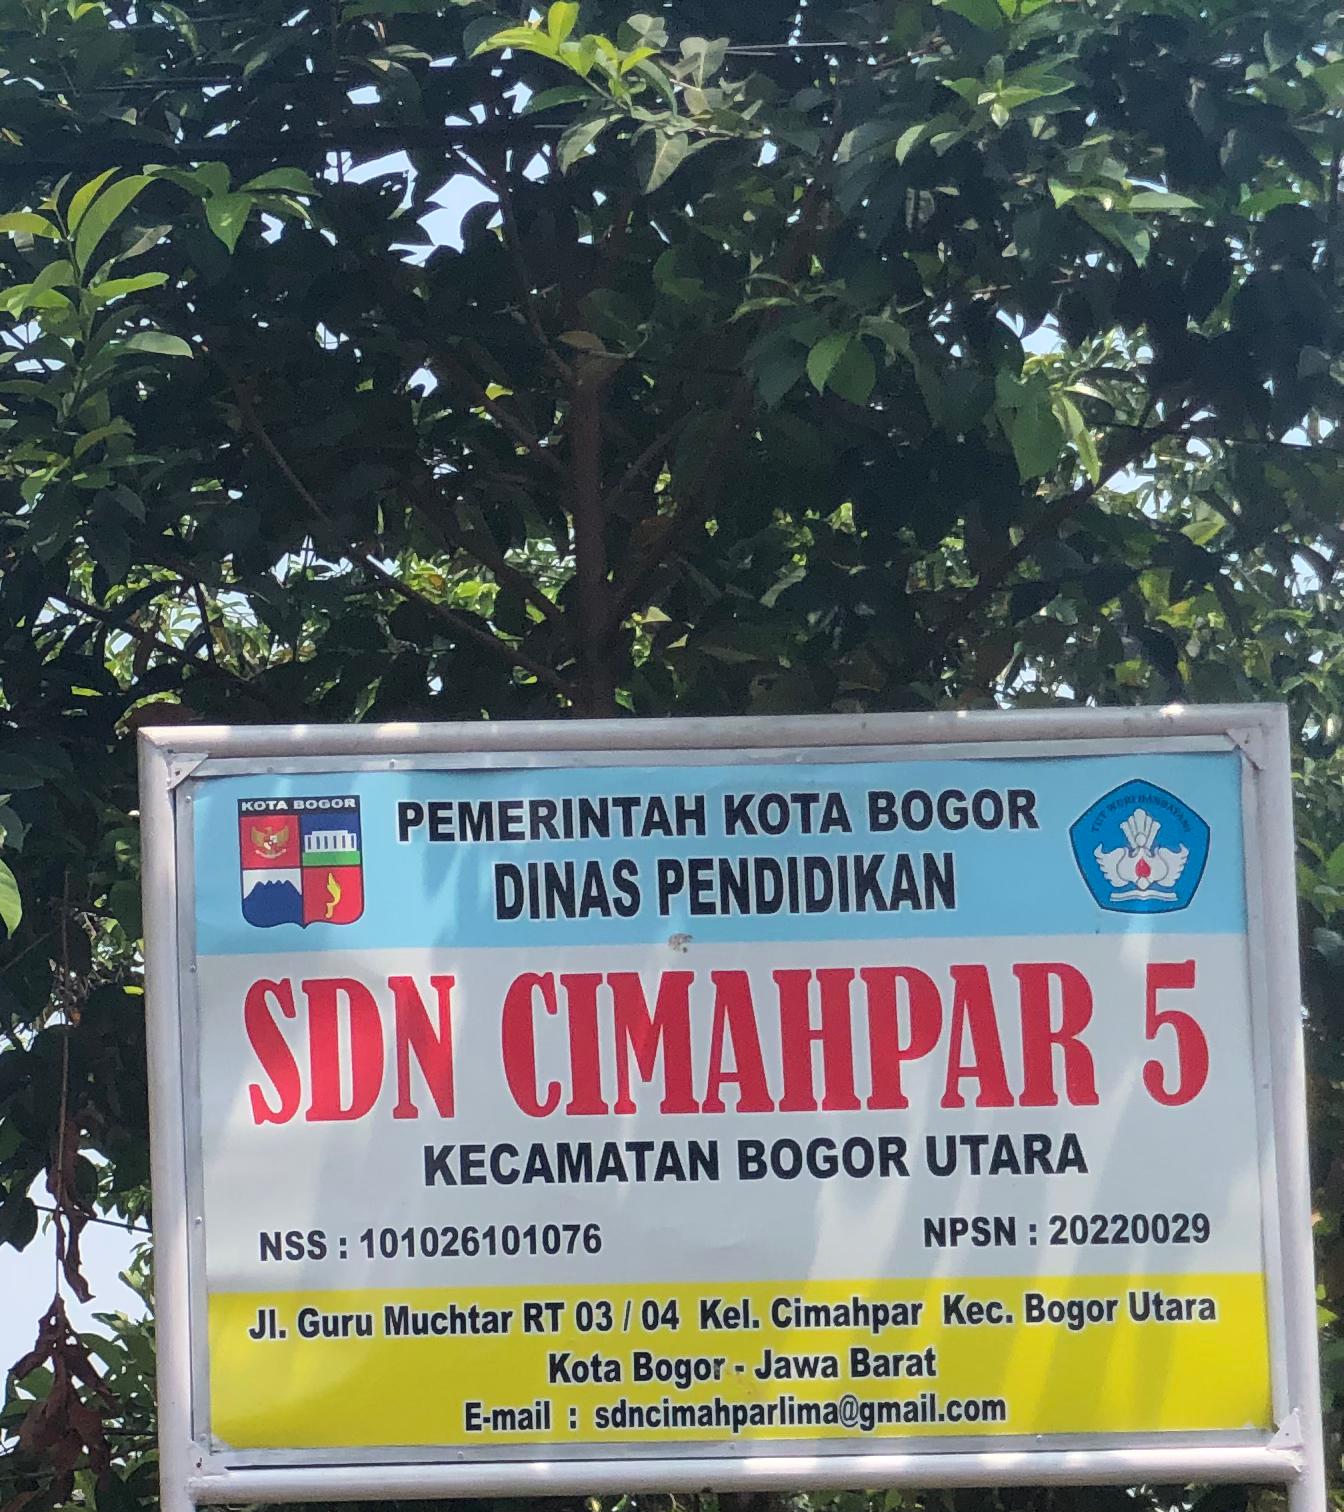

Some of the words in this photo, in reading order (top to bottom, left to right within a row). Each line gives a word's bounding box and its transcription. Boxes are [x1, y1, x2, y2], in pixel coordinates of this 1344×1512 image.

[242, 801, 288, 810] KOTA
[294, 799, 355, 809] BOGOR
[399, 796, 705, 841] PEMERINTAH
[725, 793, 852, 835] KOTA
[868, 789, 1038, 831] BOGOR
[495, 859, 640, 919] DINAS
[658, 853, 955, 915] PENDIDIKAN
[245, 976, 455, 1124] SDN
[502, 963, 1098, 1117] CIMAHPAR
[1144, 961, 1208, 1105] 5
[425, 1141, 718, 1185] KECAMATAN
[738, 1137, 910, 1179] BOGOR
[927, 1134, 1088, 1176] UTARA
[261, 1231, 326, 1261] NSS
[340, 1238, 346, 1258] :
[361, 1224, 601, 1257] 101026101076
[925, 1217, 1015, 1247] NPSN
[1030, 1225, 1036, 1245] :
[1050, 1213, 1209, 1244] 20220029
[250, 1310, 285, 1339] Jl.
[298, 1308, 372, 1337] Guru
[385, 1305, 513, 1335] Muchtar
[524, 1303, 564, 1332] RT
[576, 1301, 612, 1331] 03
[624, 1301, 631, 1331] /
[642, 1300, 679, 1330] 04
[701, 1299, 759, 1329] Kel.
[772, 1297, 922, 1333] Cimahpar
[944, 1295, 1012, 1324] Kec.
[1026, 1294, 1118, 1330] Bogor
[1130, 1292, 1215, 1321] Utara
[550, 1353, 620, 1383] Kota
[634, 1352, 725, 1389] Bogor
[755, 1350, 838, 1379] Jawa
[851, 1348, 936, 1377] Barat
[466, 1401, 550, 1431] E-mail
[570, 1408, 576, 1428] :
[596, 1394, 1005, 1433] sdncimahparlima@gmail.com
